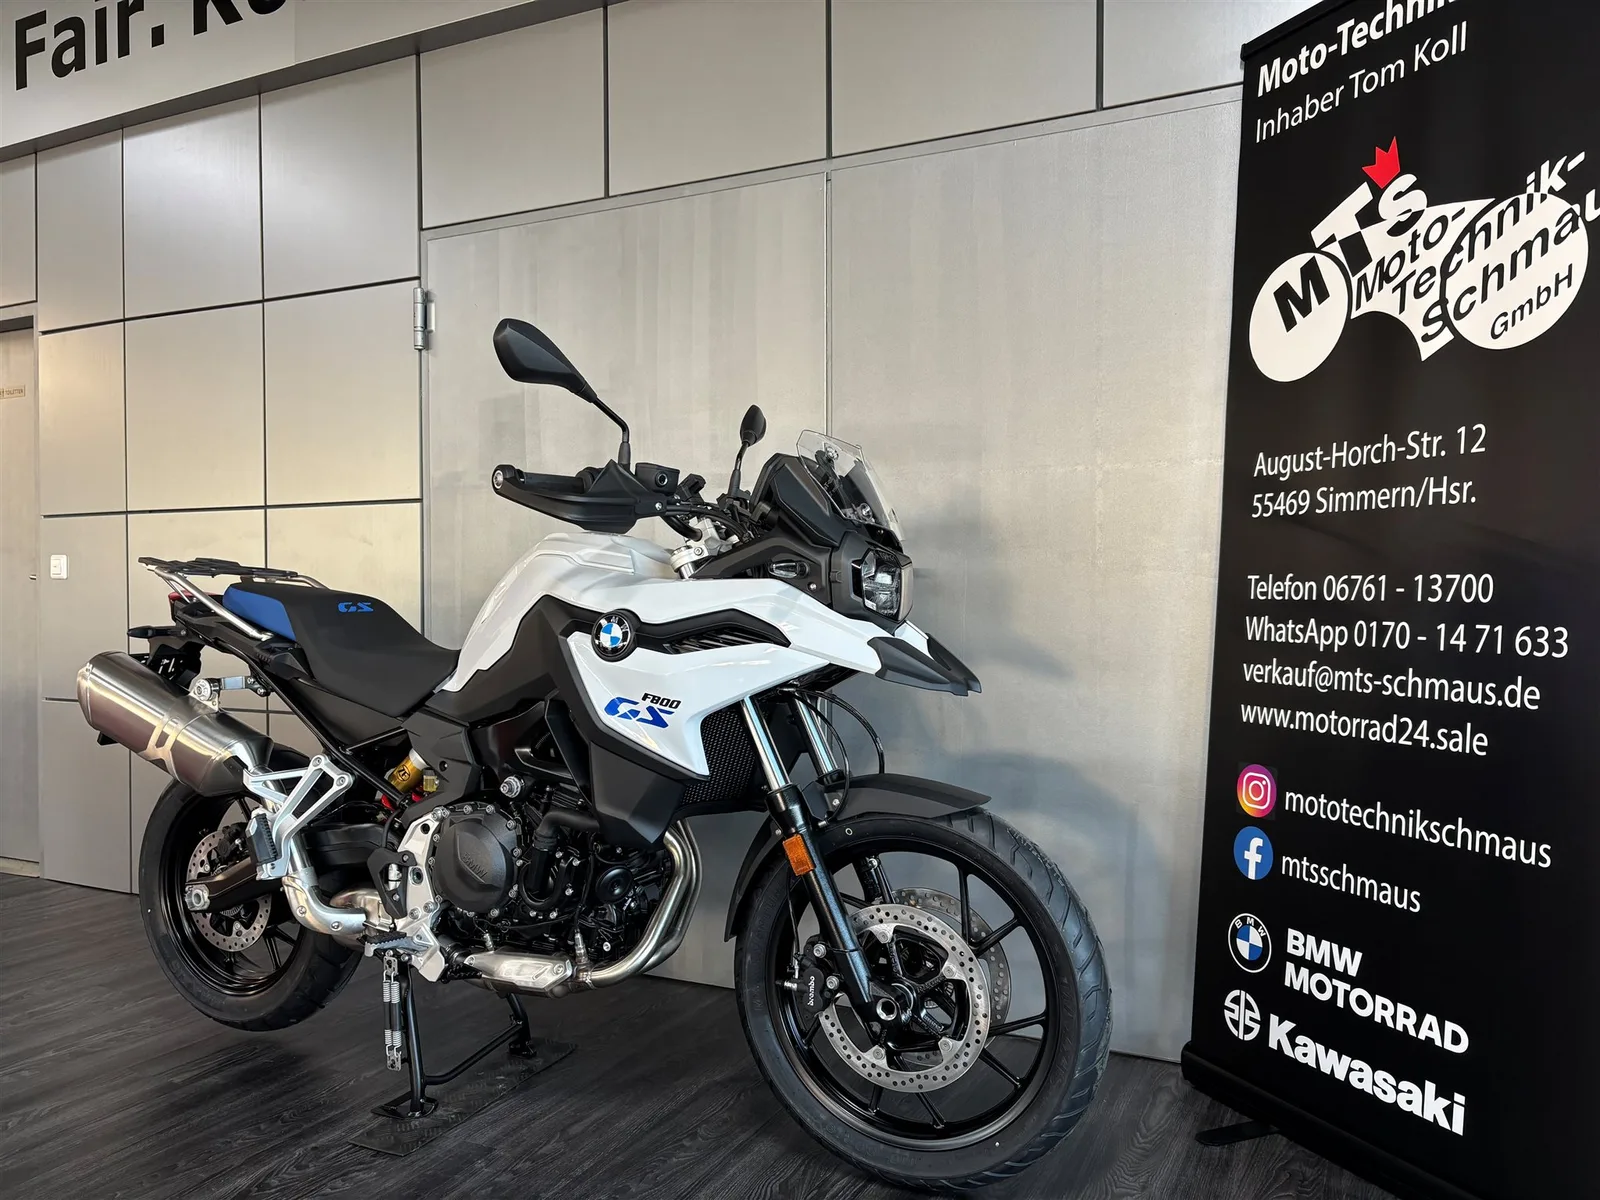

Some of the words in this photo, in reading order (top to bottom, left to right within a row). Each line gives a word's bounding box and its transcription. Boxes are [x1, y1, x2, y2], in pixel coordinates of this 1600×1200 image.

[15, 0, 165, 91] Fair.
[1257, 0, 1456, 97] Moto-Techn
[1256, 84, 1345, 144] Inhaber
[1348, 58, 1405, 99] Tom
[1414, 20, 1467, 72] Koll
[1355, 206, 1466, 312] Moto-
[1490, 263, 1573, 340] GmbH
[1253, 430, 1446, 482] August-Horch-Str.
[1456, 423, 1486, 455] 12
[1251, 489, 1311, 519] 55469
[1315, 475, 1477, 514] Simmern/Hsr.
[337, 601, 374, 613] GS
[1247, 573, 1317, 601] Telefon
[1323, 574, 1387, 602] 06761
[1414, 573, 1494, 604] 13700
[1245, 615, 1349, 653] WhatsApp
[1353, 619, 1411, 650] 0170
[1436, 622, 1467, 653] 14
[1475, 624, 1503, 655] 71
[1514, 625, 1569, 659] 633
[603, 696, 675, 729] GS
[641, 692, 682, 710] F800
[1242, 657, 1541, 710] verkauf@mts-schmaus.de
[1240, 703, 1489, 756] www.motorrad24.sale
[1285, 791, 1552, 868] mototechnikschmaus
[1281, 855, 1421, 913] mtsschmaus
[1286, 927, 1363, 978] BMW
[1284, 961, 1469, 1054] MOTORRAD
[1268, 1013, 1466, 1136] Kawasaki
